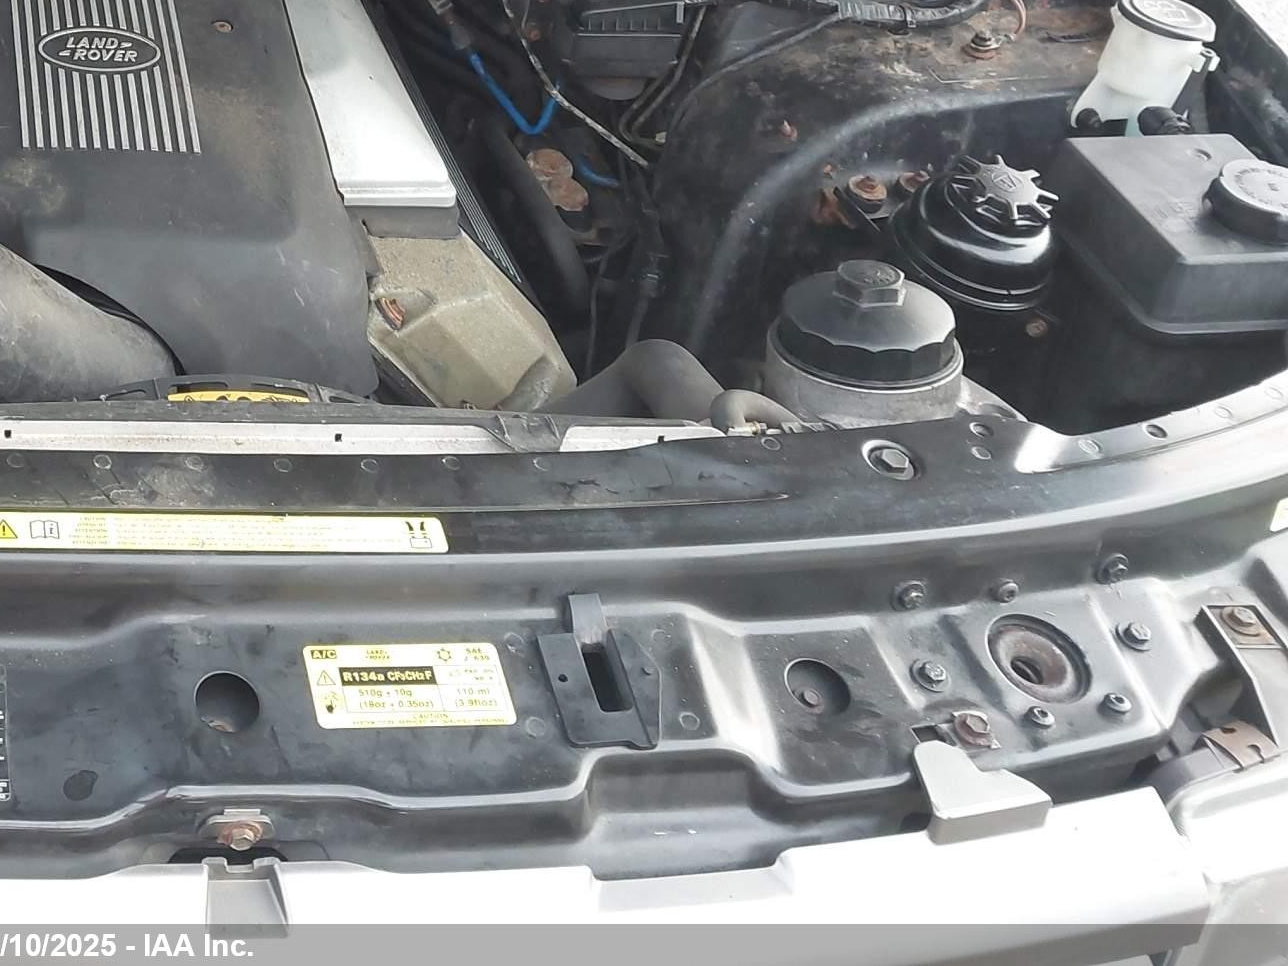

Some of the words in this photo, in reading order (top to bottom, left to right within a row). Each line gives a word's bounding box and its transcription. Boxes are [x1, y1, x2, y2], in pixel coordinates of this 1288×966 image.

[66, 36, 119, 49] LAND
[72, 49, 138, 62] ROVER
[312, 650, 337, 659] A/C
[342, 671, 386, 682] R134a
